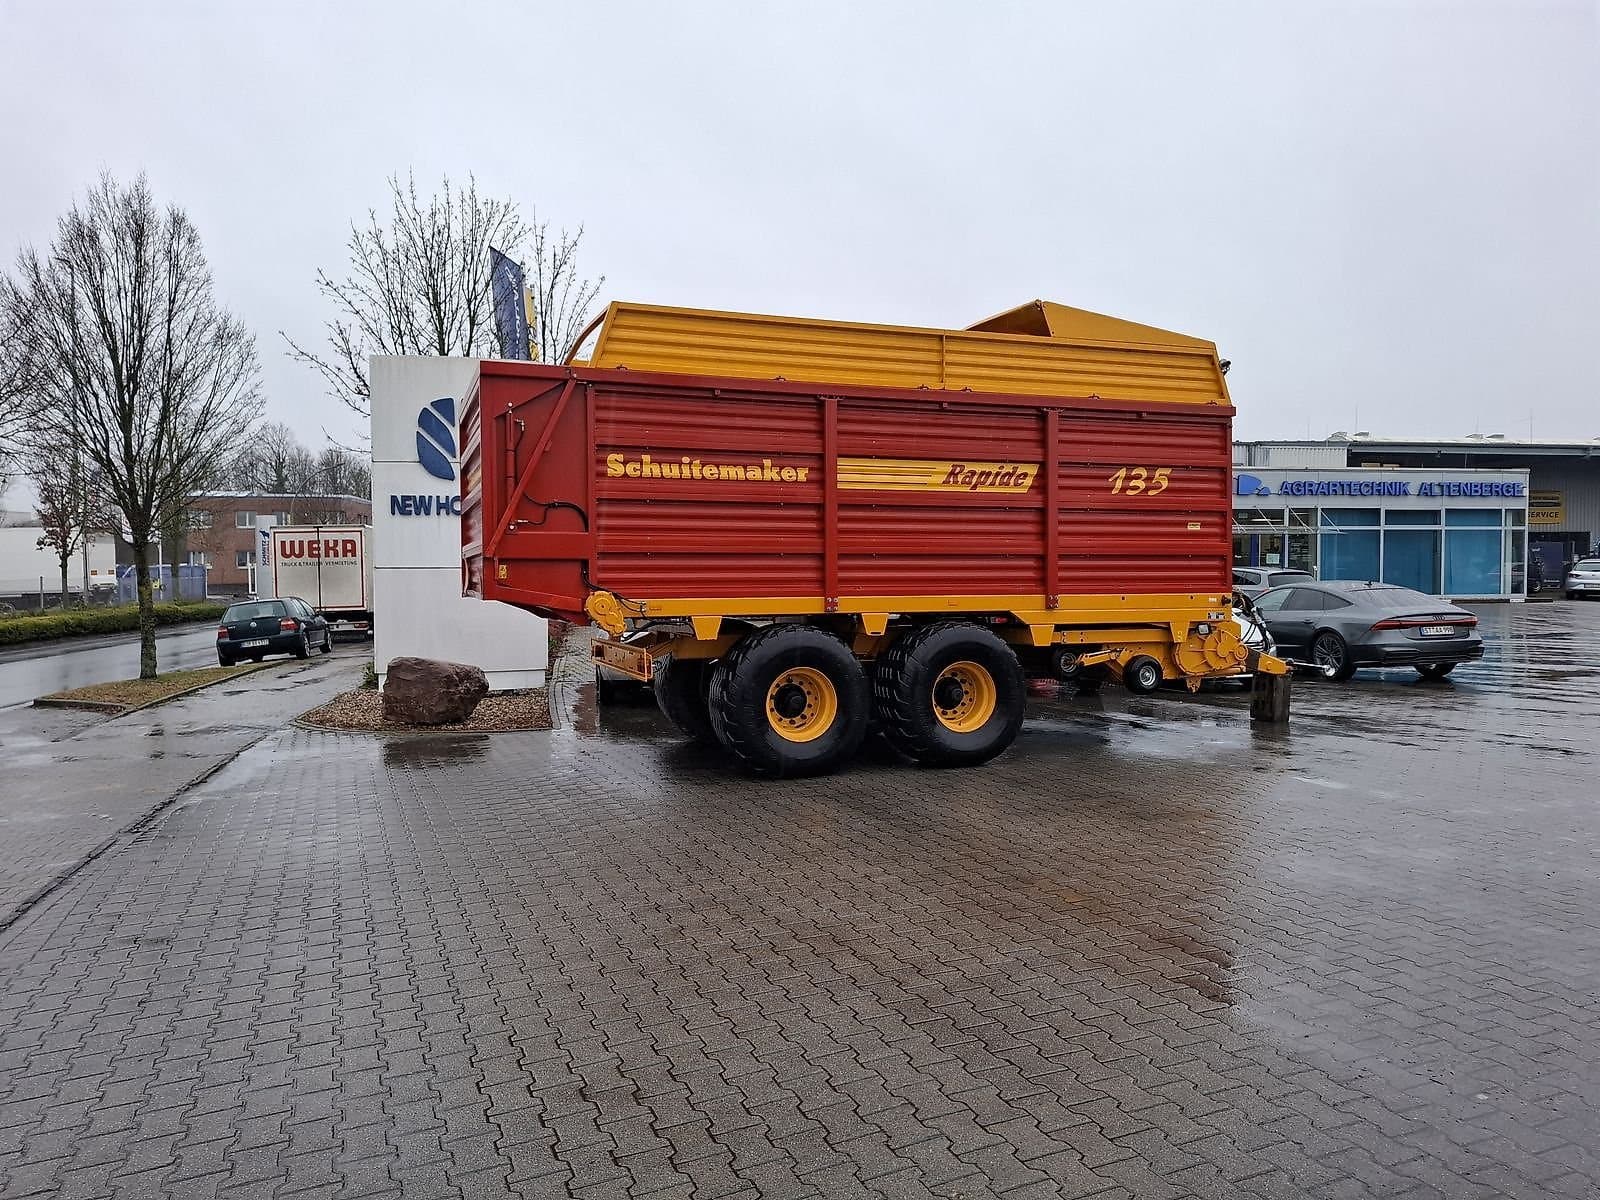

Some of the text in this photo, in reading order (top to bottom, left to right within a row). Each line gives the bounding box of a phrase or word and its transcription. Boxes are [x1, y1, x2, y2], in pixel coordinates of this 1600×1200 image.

[606, 453, 809, 482] Schuitemaker
[942, 464, 1029, 491] Rapide
[1108, 466, 1173, 496] 135
[1280, 480, 1525, 497] AGRARTECHNIK ALTENBERGE
[390, 495, 432, 515] NEW
[280, 539, 357, 559] WEKA
